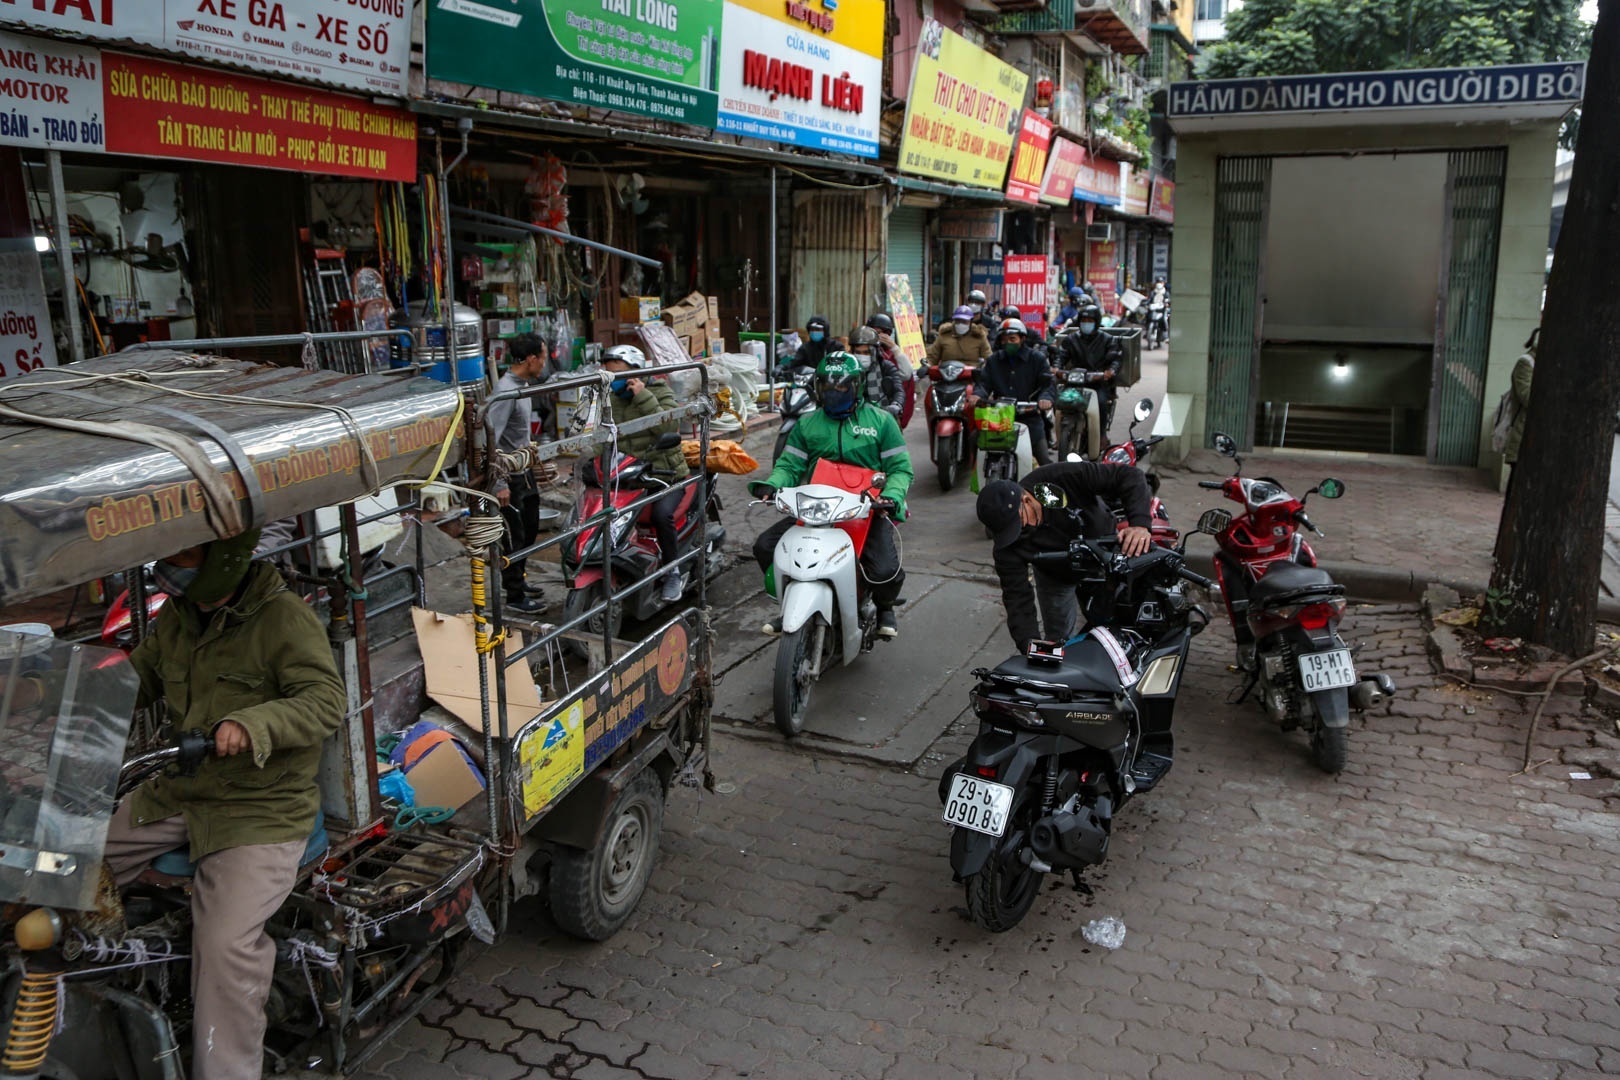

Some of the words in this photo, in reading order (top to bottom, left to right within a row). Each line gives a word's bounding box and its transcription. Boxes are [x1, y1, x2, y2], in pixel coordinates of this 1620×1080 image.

[248, 0, 287, 32] GA
[315, 13, 348, 46] XE
[357, 22, 390, 54] SỐ
[636, 0, 678, 32] LONG
[196, 23, 234, 37] HONDA
[253, 36, 285, 48] YAMAHA
[786, 32, 804, 52] CỬA
[303, 46, 332, 58] PIAGGIO
[349, 57, 374, 68] SUZUKI
[44, 54, 96, 81] KHẢI
[743, 49, 813, 103] MẠNH
[0, 78, 70, 104] MOTOR
[556, 65, 568, 79] Địa
[606, 75, 624, 90] Khuất
[625, 80, 636, 95] Duy
[651, 86, 666, 98] Thanh
[682, 93, 689, 104] Hà
[572, 86, 588, 100] Điện
[1173, 81, 1235, 114] HẦM
[1241, 78, 1322, 110] DÀNH
[1328, 79, 1387, 107] CHO
[1392, 69, 1491, 105] NGƯỜI
[1496, 73, 1530, 100] ĐI
[110, 64, 138, 98] SỬA
[141, 73, 178, 104] CHỮA
[181, 76, 206, 109] BẢO
[210, 84, 250, 115] DƯỠNG
[260, 94, 289, 120] THAY
[291, 95, 312, 124] THẾ
[313, 104, 334, 132] PHỤ
[336, 104, 360, 132] TÙNG
[363, 111, 391, 137] CHÍNH
[393, 114, 416, 141] HÀNG
[934, 71, 958, 116] THỊT
[976, 90, 997, 130] VIỆT
[0, 108, 29, 138] BÁN
[42, 117, 78, 143] TRAO
[81, 113, 103, 145] ĐỔI
[158, 115, 182, 146] TÂN
[186, 123, 226, 151] TRANG
[228, 125, 252, 154] LÀM
[255, 129, 277, 158] MỚI
[288, 137, 316, 165] PHỤC
[318, 135, 336, 164] HỒI
[338, 144, 350, 166] XE
[352, 146, 366, 168] TAI
[368, 148, 387, 174] NẠN
[1006, 278, 1026, 306] THÁI
[1026, 283, 1045, 306] LAN
[824, 364, 843, 372] Grab
[852, 424, 878, 438] Grab
[86, 496, 156, 542] CÔNG
[153, 484, 183, 522] TY
[278, 444, 329, 488] ĐỒNG
[392, 414, 452, 455] TRƯỜNG
[1306, 668, 1352, 689] 041.16
[1066, 712, 1112, 720] AIRBLADE
